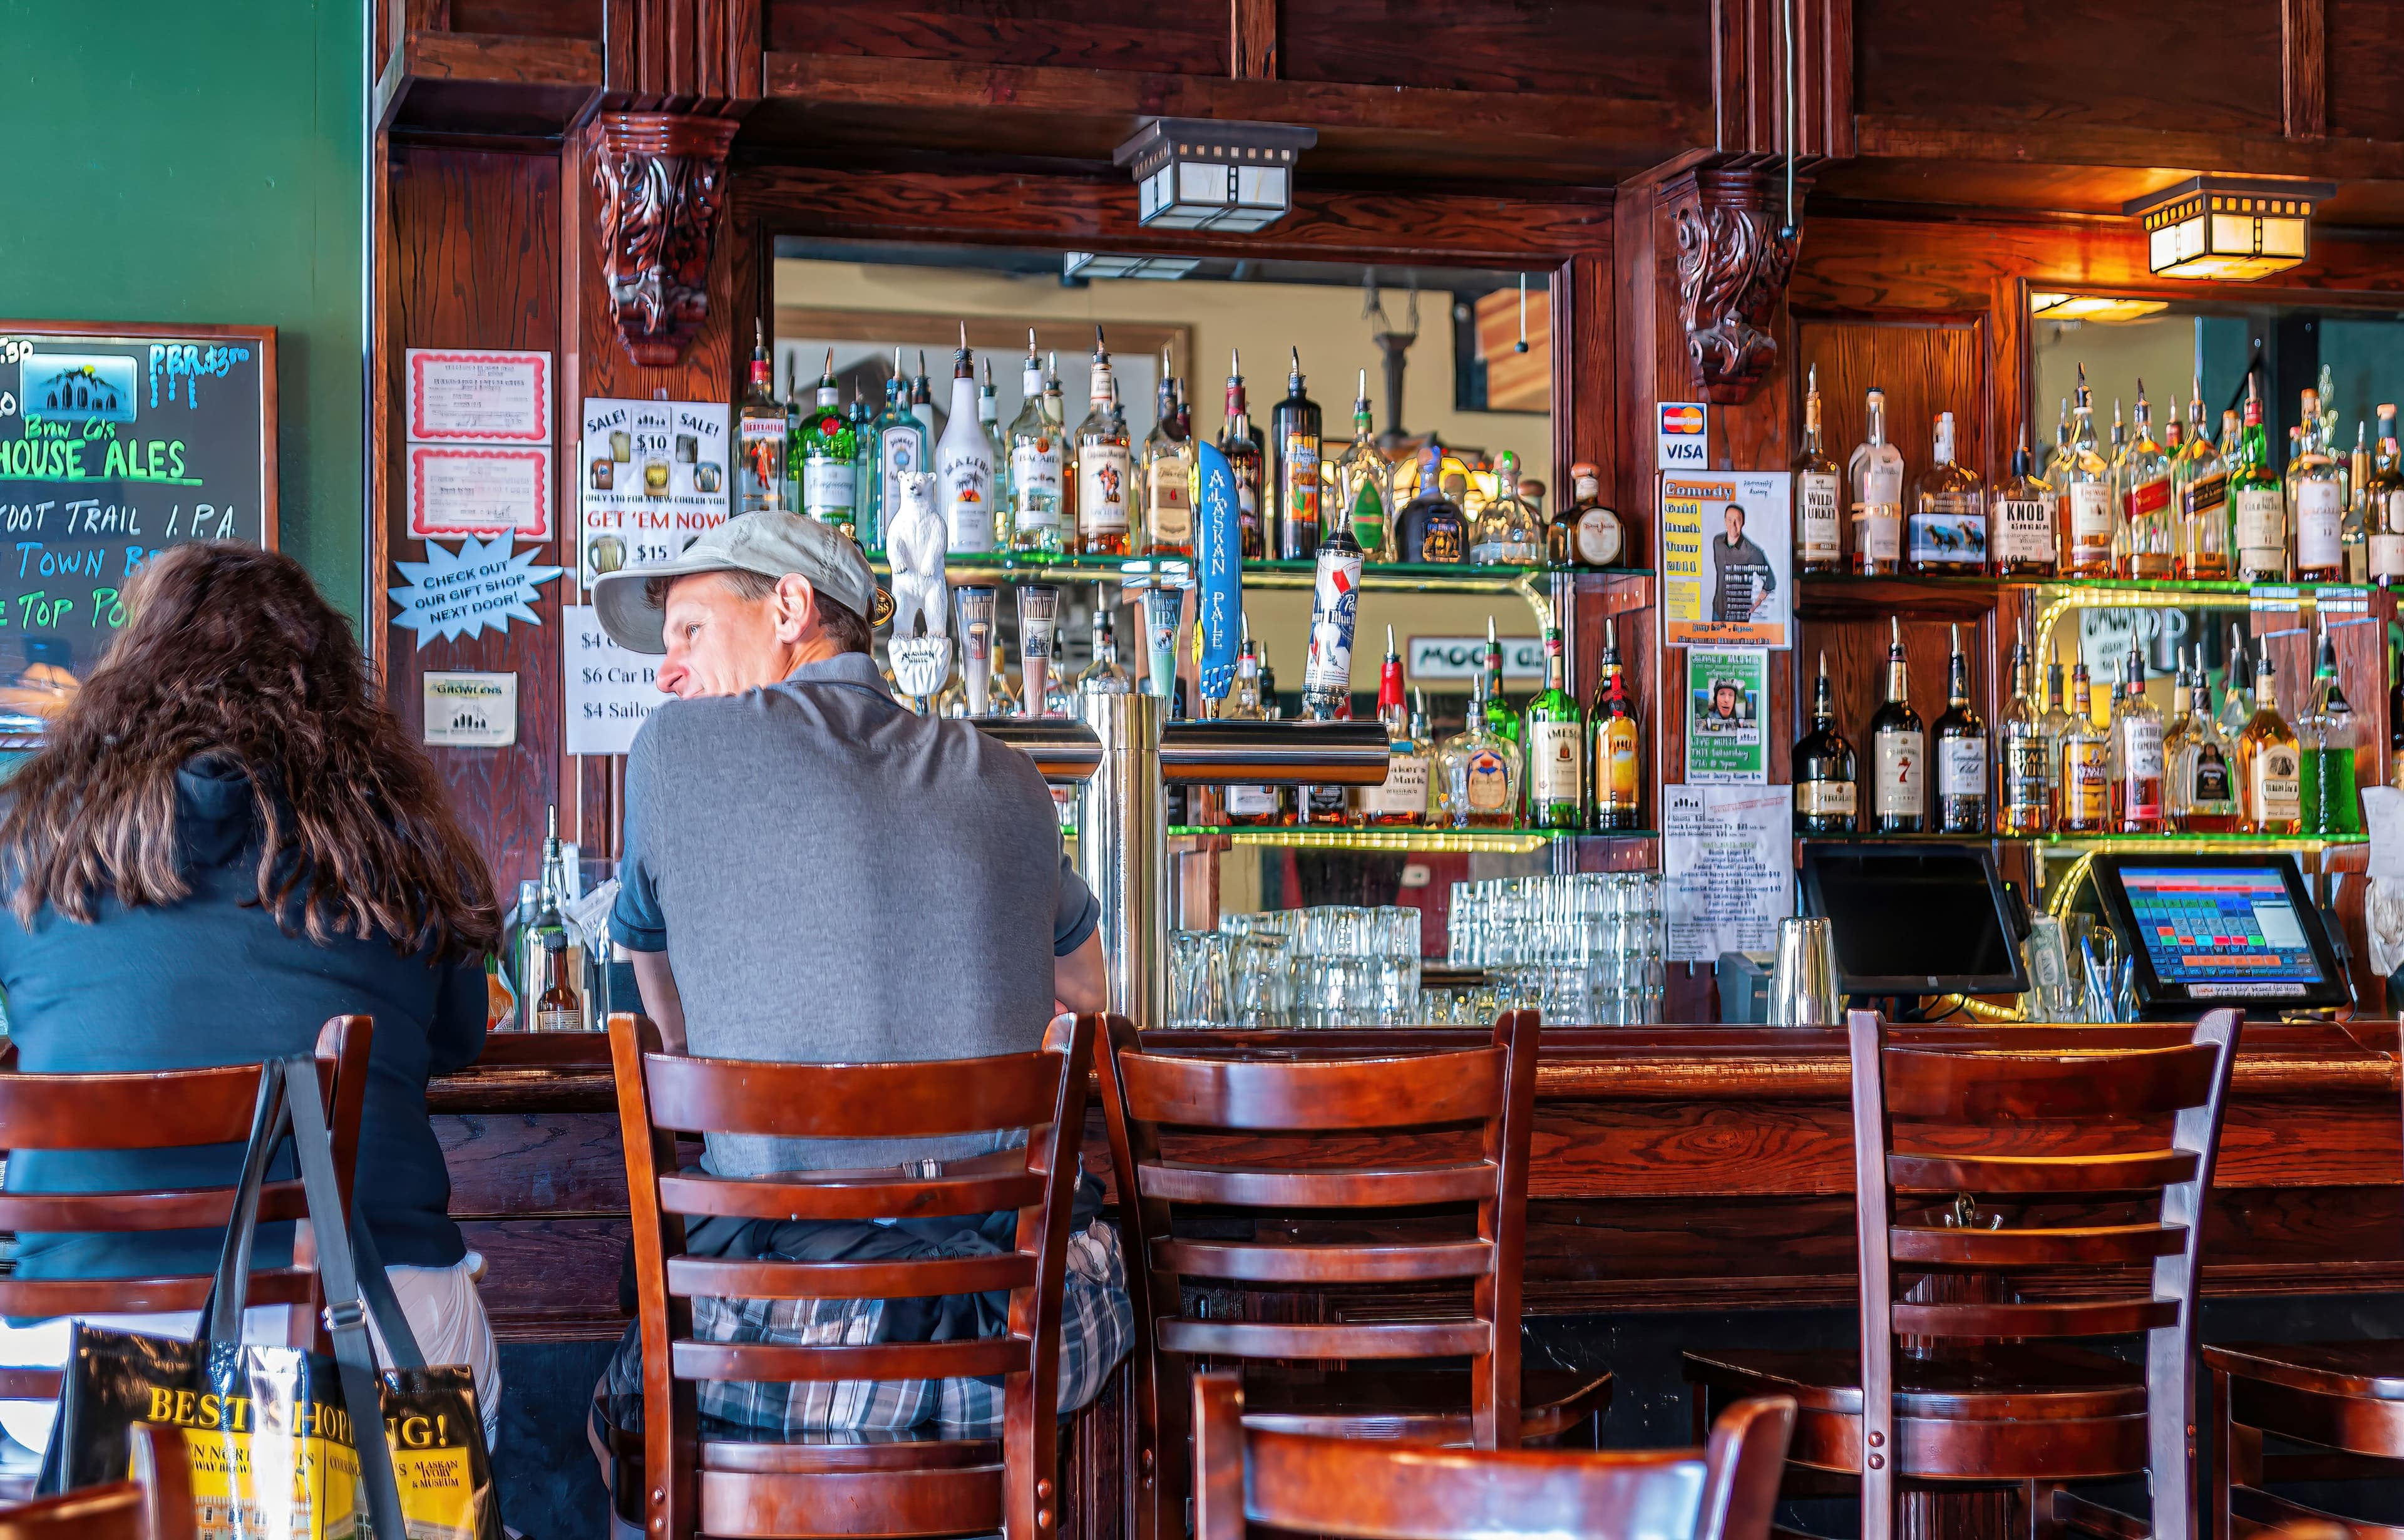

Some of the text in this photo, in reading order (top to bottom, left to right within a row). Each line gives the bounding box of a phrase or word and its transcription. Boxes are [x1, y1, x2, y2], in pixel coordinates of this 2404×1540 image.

[587, 408, 627, 433] SALE!
[681, 413, 719, 438] SALE!
[637, 433, 667, 452] $10
[1666, 444, 1703, 459] VISA
[105, 439, 185, 481] ALES
[1665, 483, 1734, 500] Comedy
[1808, 491, 1833, 506] WILD
[66, 499, 140, 535] TRAIL
[587, 510, 726, 531] GET 'EM NOW
[1208, 468, 1227, 575] ALASKAN
[2006, 502, 2045, 521] KNOB
[16, 542, 105, 580] TOWN
[637, 544, 667, 562] $15
[423, 560, 508, 589] CHECK OUT
[415, 573, 525, 609] OUR GIFT SHOP
[18, 590, 73, 630] TOP
[430, 590, 519, 625] NEXT DOOR!
[1154, 611, 1178, 625] IPA
[1210, 591, 1224, 649] PALE
[582, 632, 601, 650] $4
[583, 666, 655, 685] $6 Car B
[583, 702, 602, 721] $4
[1897, 761, 1911, 783] 7
[148, 1386, 255, 1432] BEST
[414, 1460, 458, 1470] ALASKAN
